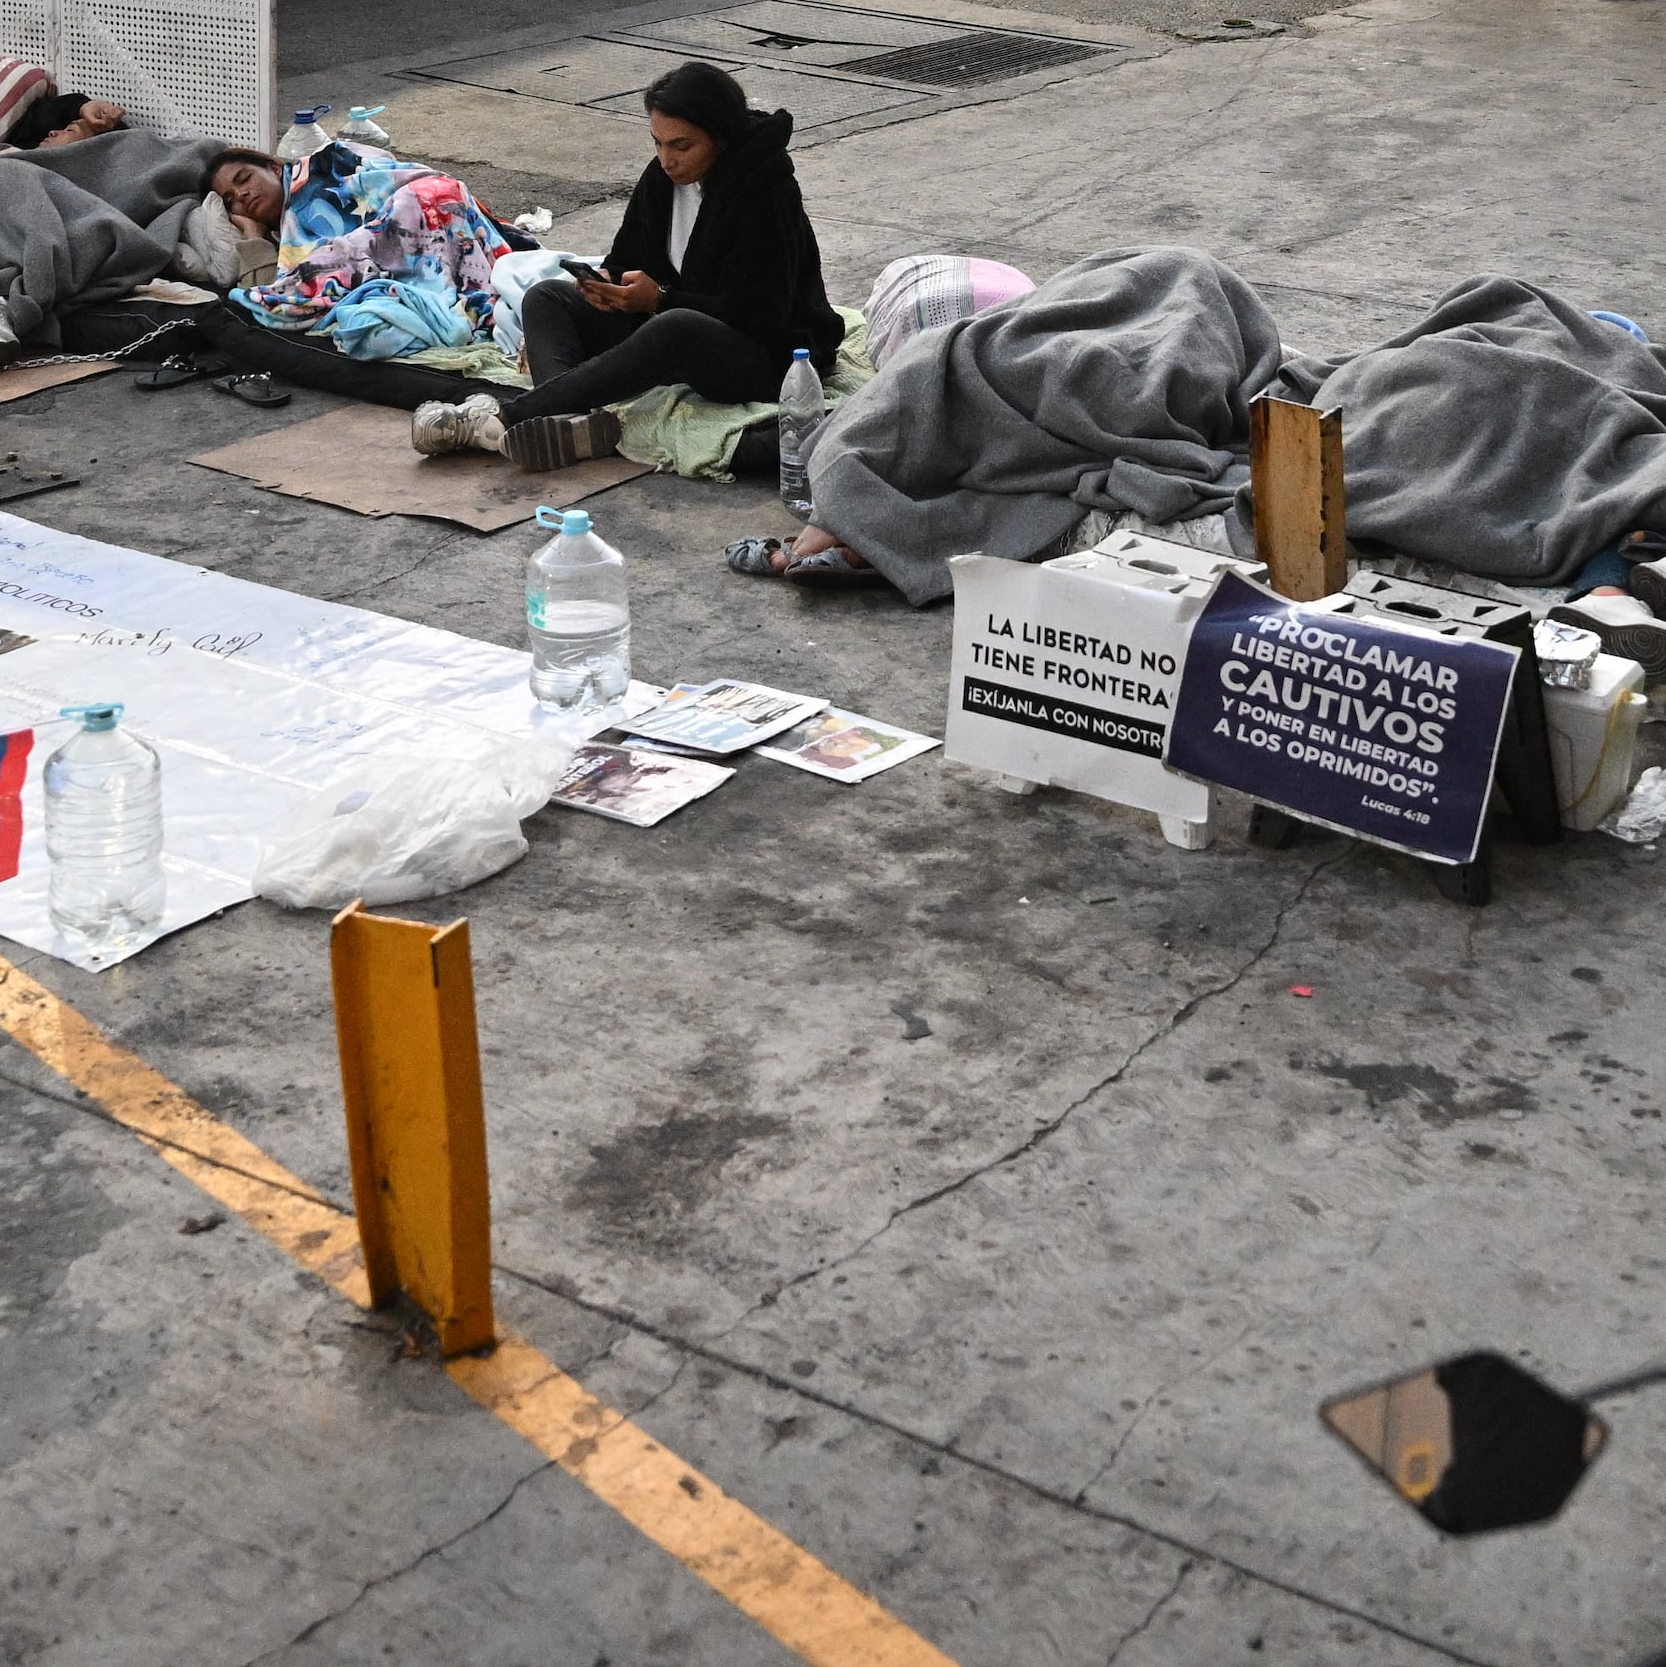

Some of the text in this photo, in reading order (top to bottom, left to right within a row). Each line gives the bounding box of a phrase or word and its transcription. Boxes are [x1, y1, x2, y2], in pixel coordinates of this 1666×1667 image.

[971, 642, 1173, 709] TIENE FRONTERA
[988, 613, 1176, 676] LA LIBERTAD NO
[1232, 633, 1457, 720] LIBERTAD A LOS
[968, 686, 1165, 750] ¡EXÍJANLA CON NOSOTR
[1213, 718, 1231, 737] A
[1237, 724, 1283, 752] LOS
[1219, 660, 1445, 754] CAUTIVOS
[1221, 695, 1439, 776] Y PONER EN LIBERTAD
[1361, 795, 1431, 826] Lucas 4:18
